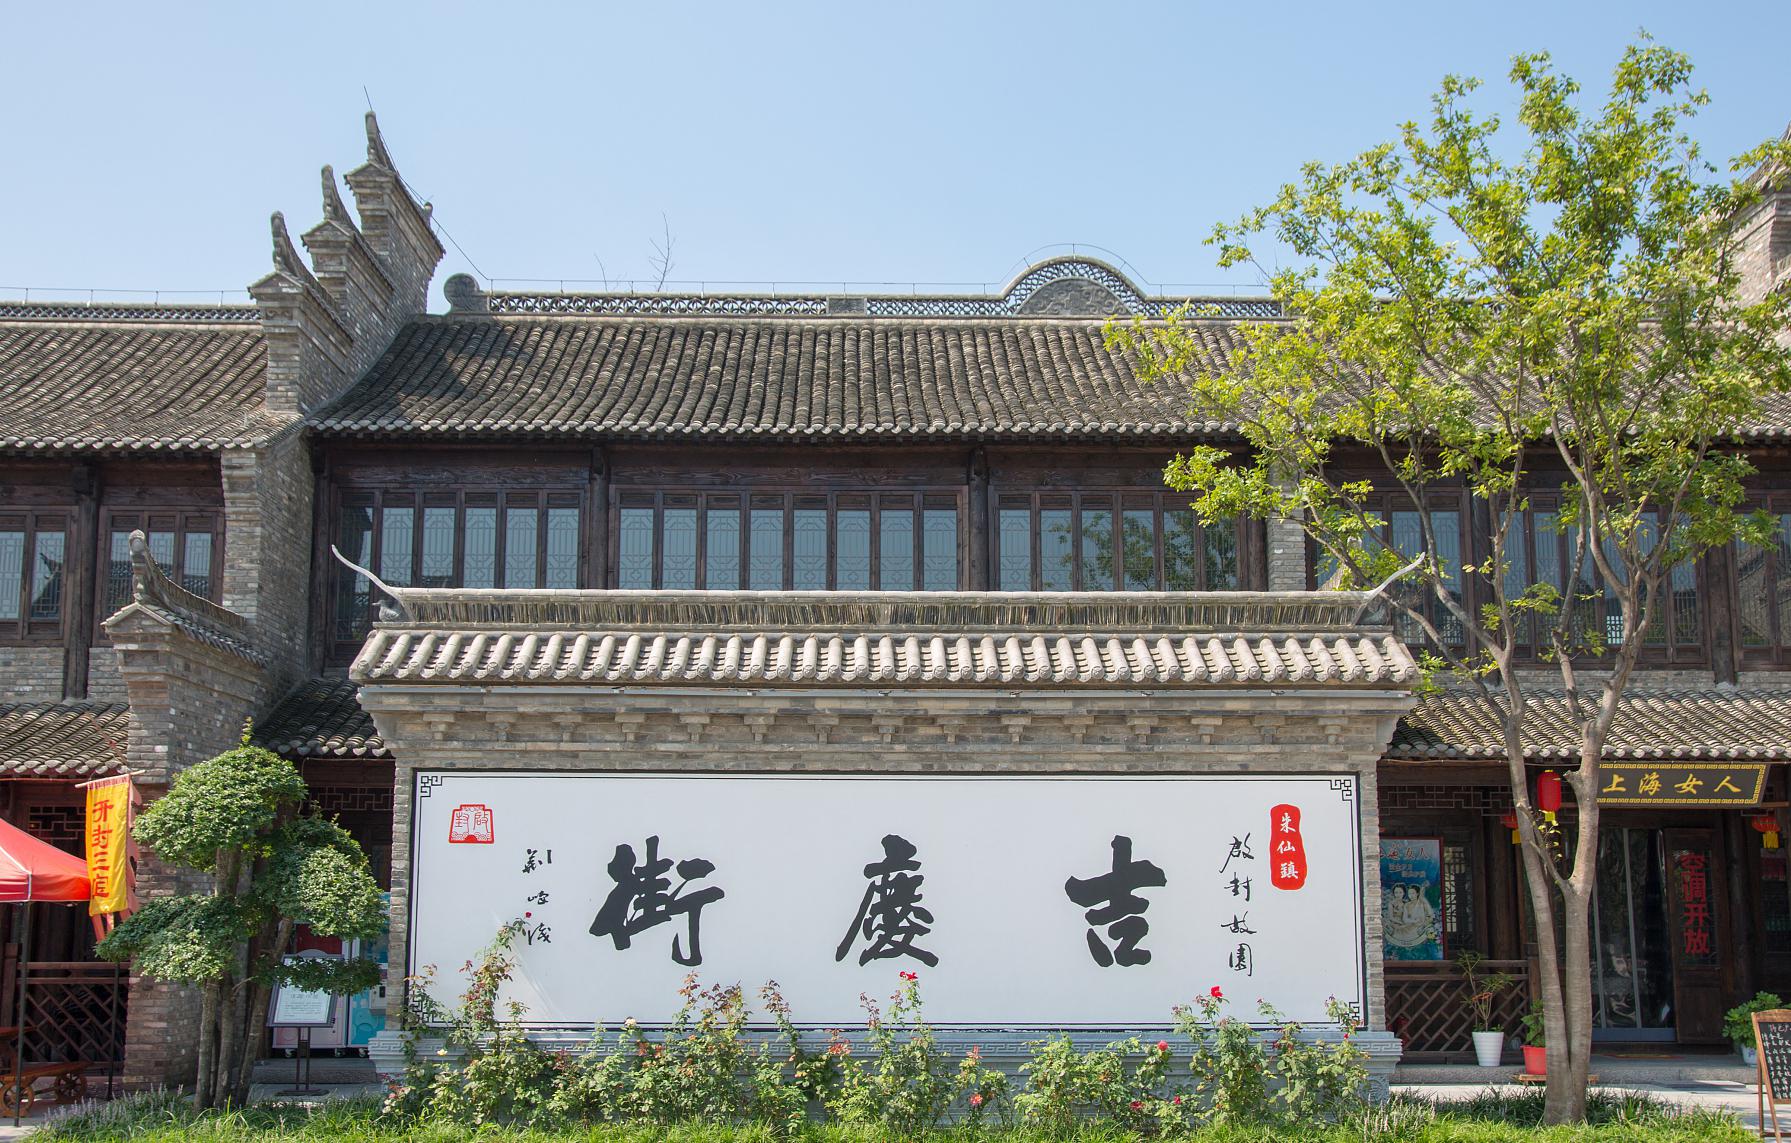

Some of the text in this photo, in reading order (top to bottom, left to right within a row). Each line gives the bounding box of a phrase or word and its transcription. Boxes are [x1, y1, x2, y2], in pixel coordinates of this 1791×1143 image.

[1602, 772, 1742, 796] 上海女人
[1681, 852, 1711, 954] 空调开放
